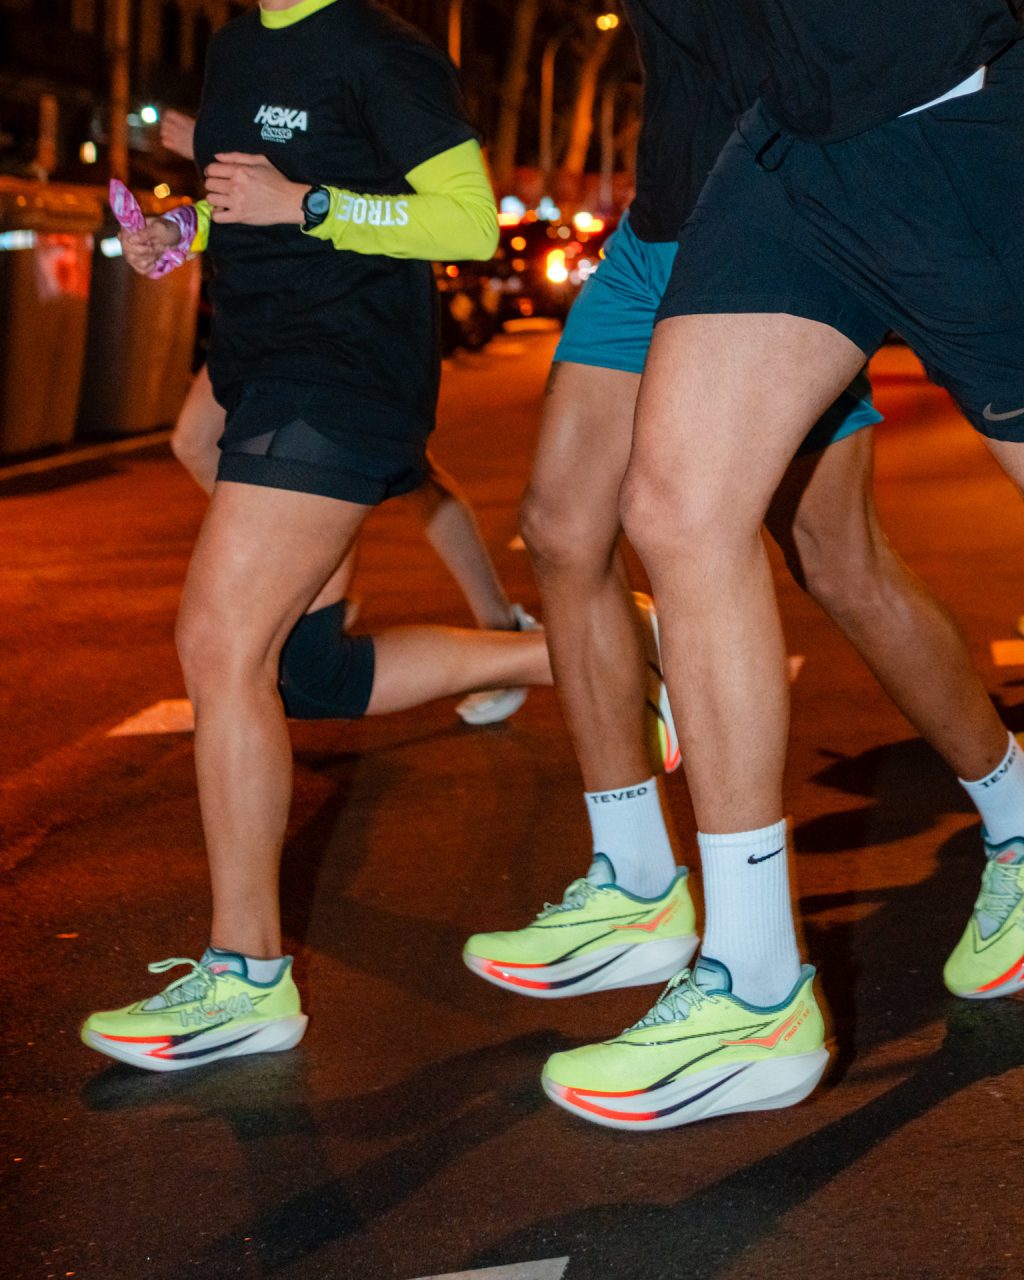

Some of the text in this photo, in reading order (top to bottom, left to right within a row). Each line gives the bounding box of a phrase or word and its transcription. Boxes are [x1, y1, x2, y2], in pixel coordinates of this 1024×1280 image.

[254, 105, 307, 131] HOKA
[589, 786, 648, 804] TEVEO
[179, 992, 254, 1027] HOKA
